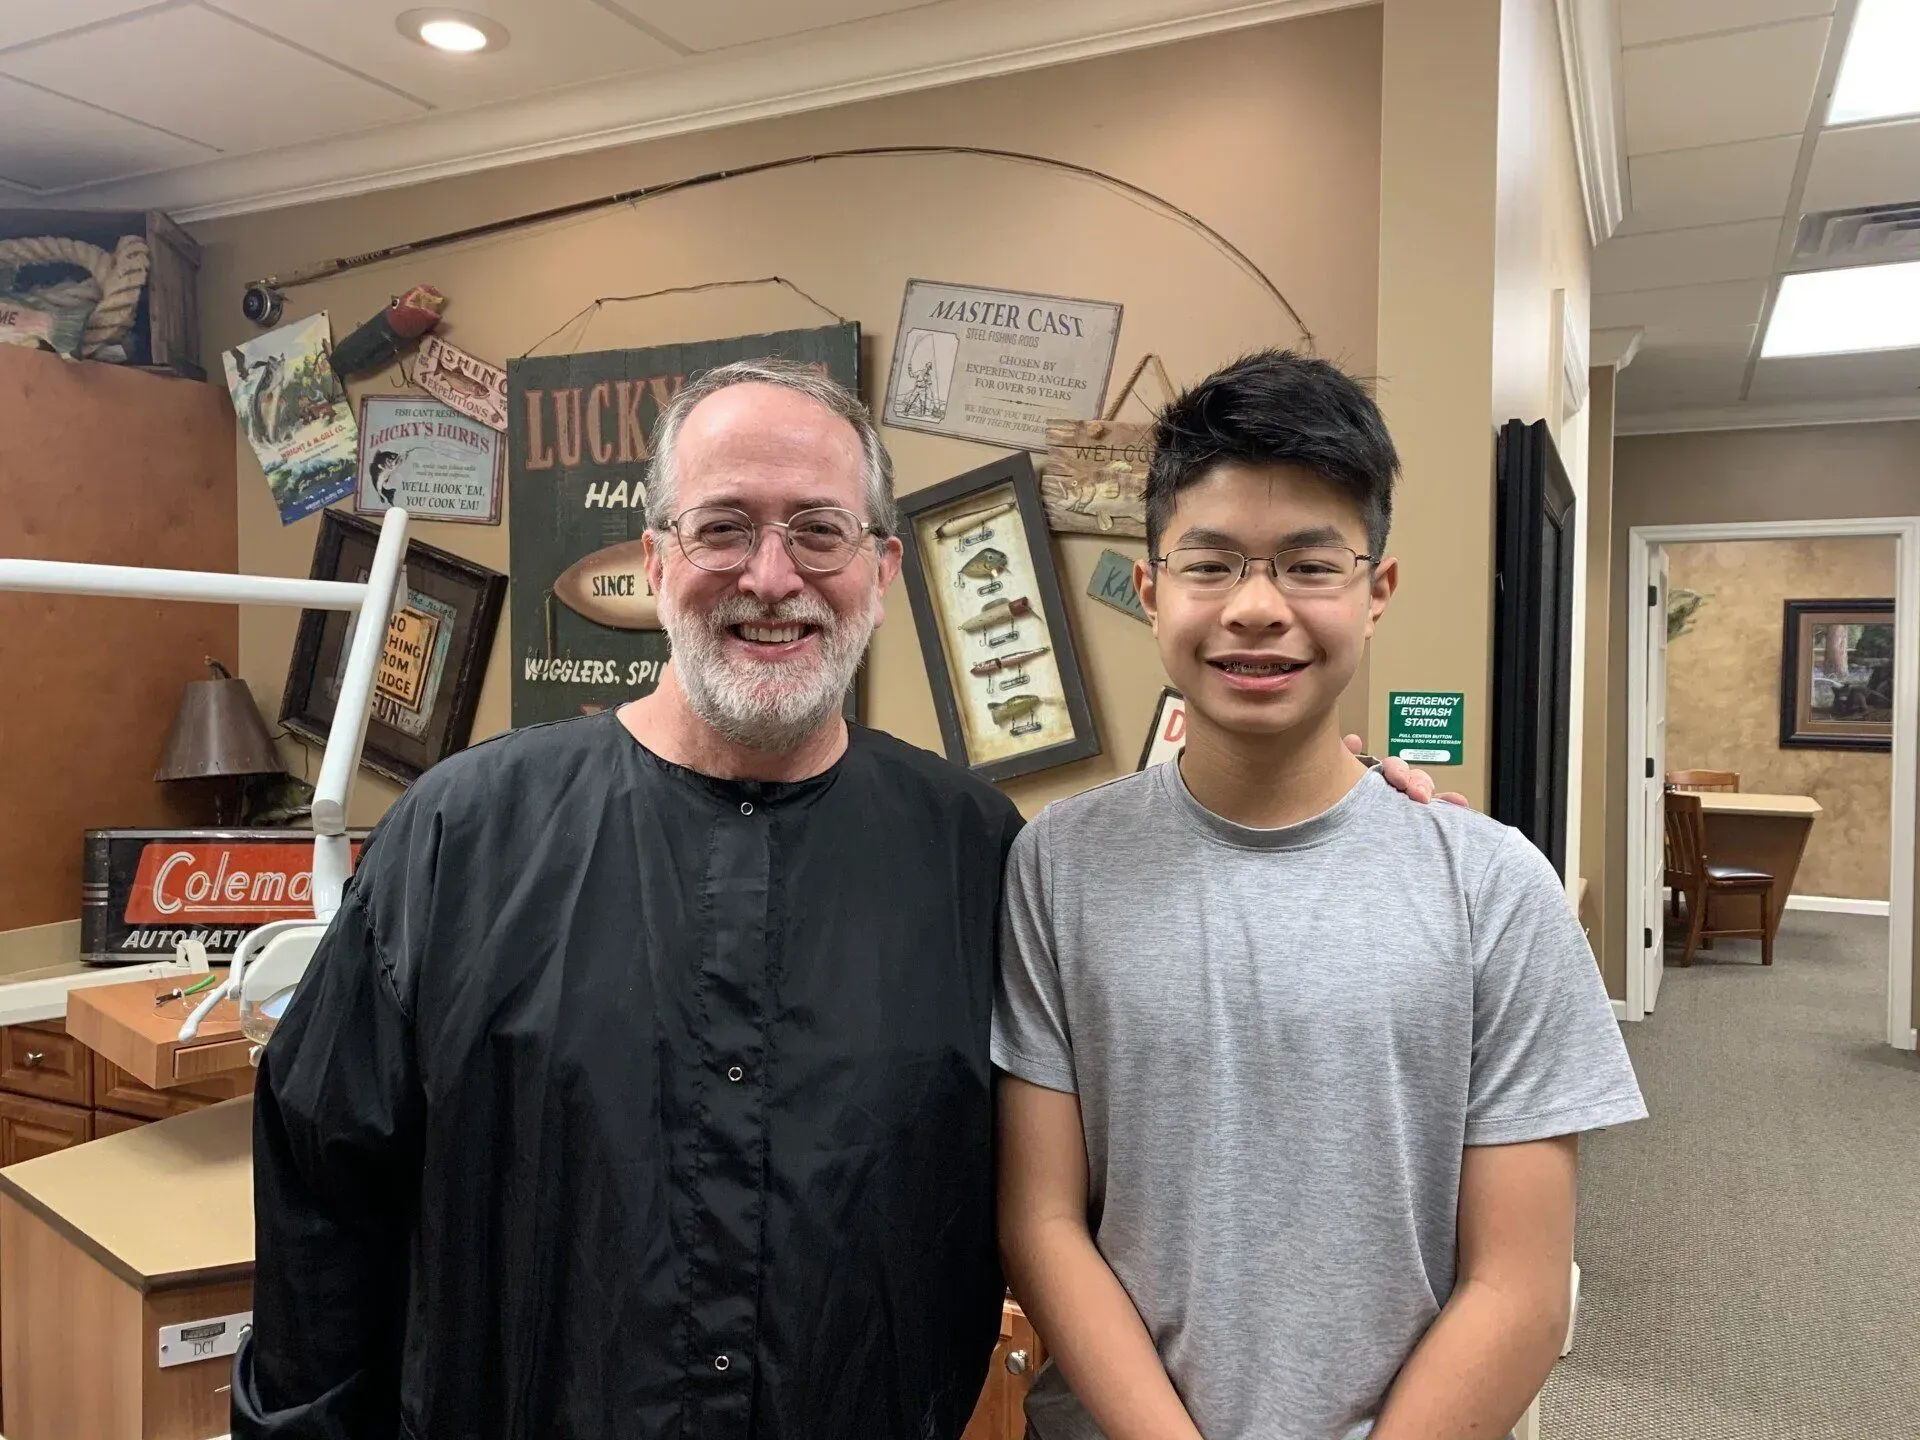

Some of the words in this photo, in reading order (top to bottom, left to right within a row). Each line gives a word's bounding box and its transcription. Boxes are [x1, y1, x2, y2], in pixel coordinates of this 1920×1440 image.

[929, 300, 1020, 329] MASTER
[1028, 308, 1084, 338] CAST
[965, 327, 986, 341] STEEL
[988, 330, 1017, 345] FISHING
[1018, 334, 1040, 348] RODS
[1000, 355, 1040, 368] CHOSEN
[1043, 361, 1056, 372] BY
[966, 363, 1036, 382] EXPERIENCED
[1037, 374, 1087, 390] ANGLERS
[427, 379, 489, 418] EXPEDITIONS
[975, 377, 995, 390] FOR
[997, 381, 1024, 395] OVER
[1026, 386, 1037, 396] 50
[1039, 387, 1073, 401] YEARS
[394, 408, 412, 417] FISH
[412, 408, 435, 418] CAN'T
[978, 405, 1001, 416] THINK
[1004, 409, 1021, 419] YOU
[370, 421, 434, 449] LUCKY'S
[437, 422, 490, 454] LURES
[1076, 444, 1149, 463] WELCO
[401, 480, 430, 493] WE'LL
[433, 482, 464, 495] HOOK
[585, 480, 647, 509] HAN
[406, 495, 426, 507] YOU
[428, 497, 457, 509] COOK
[592, 574, 635, 597] SINCE
[388, 634, 421, 659] HING
[525, 657, 620, 685] WIGGLERS,
[1394, 696, 1460, 706] EMERGENCY
[1400, 707, 1452, 717] EYEWASH
[1164, 708, 1185, 743] D
[1404, 717, 1448, 728] STATION
[153, 851, 313, 915] Colema
[121, 929, 247, 949] AUTOMATI
